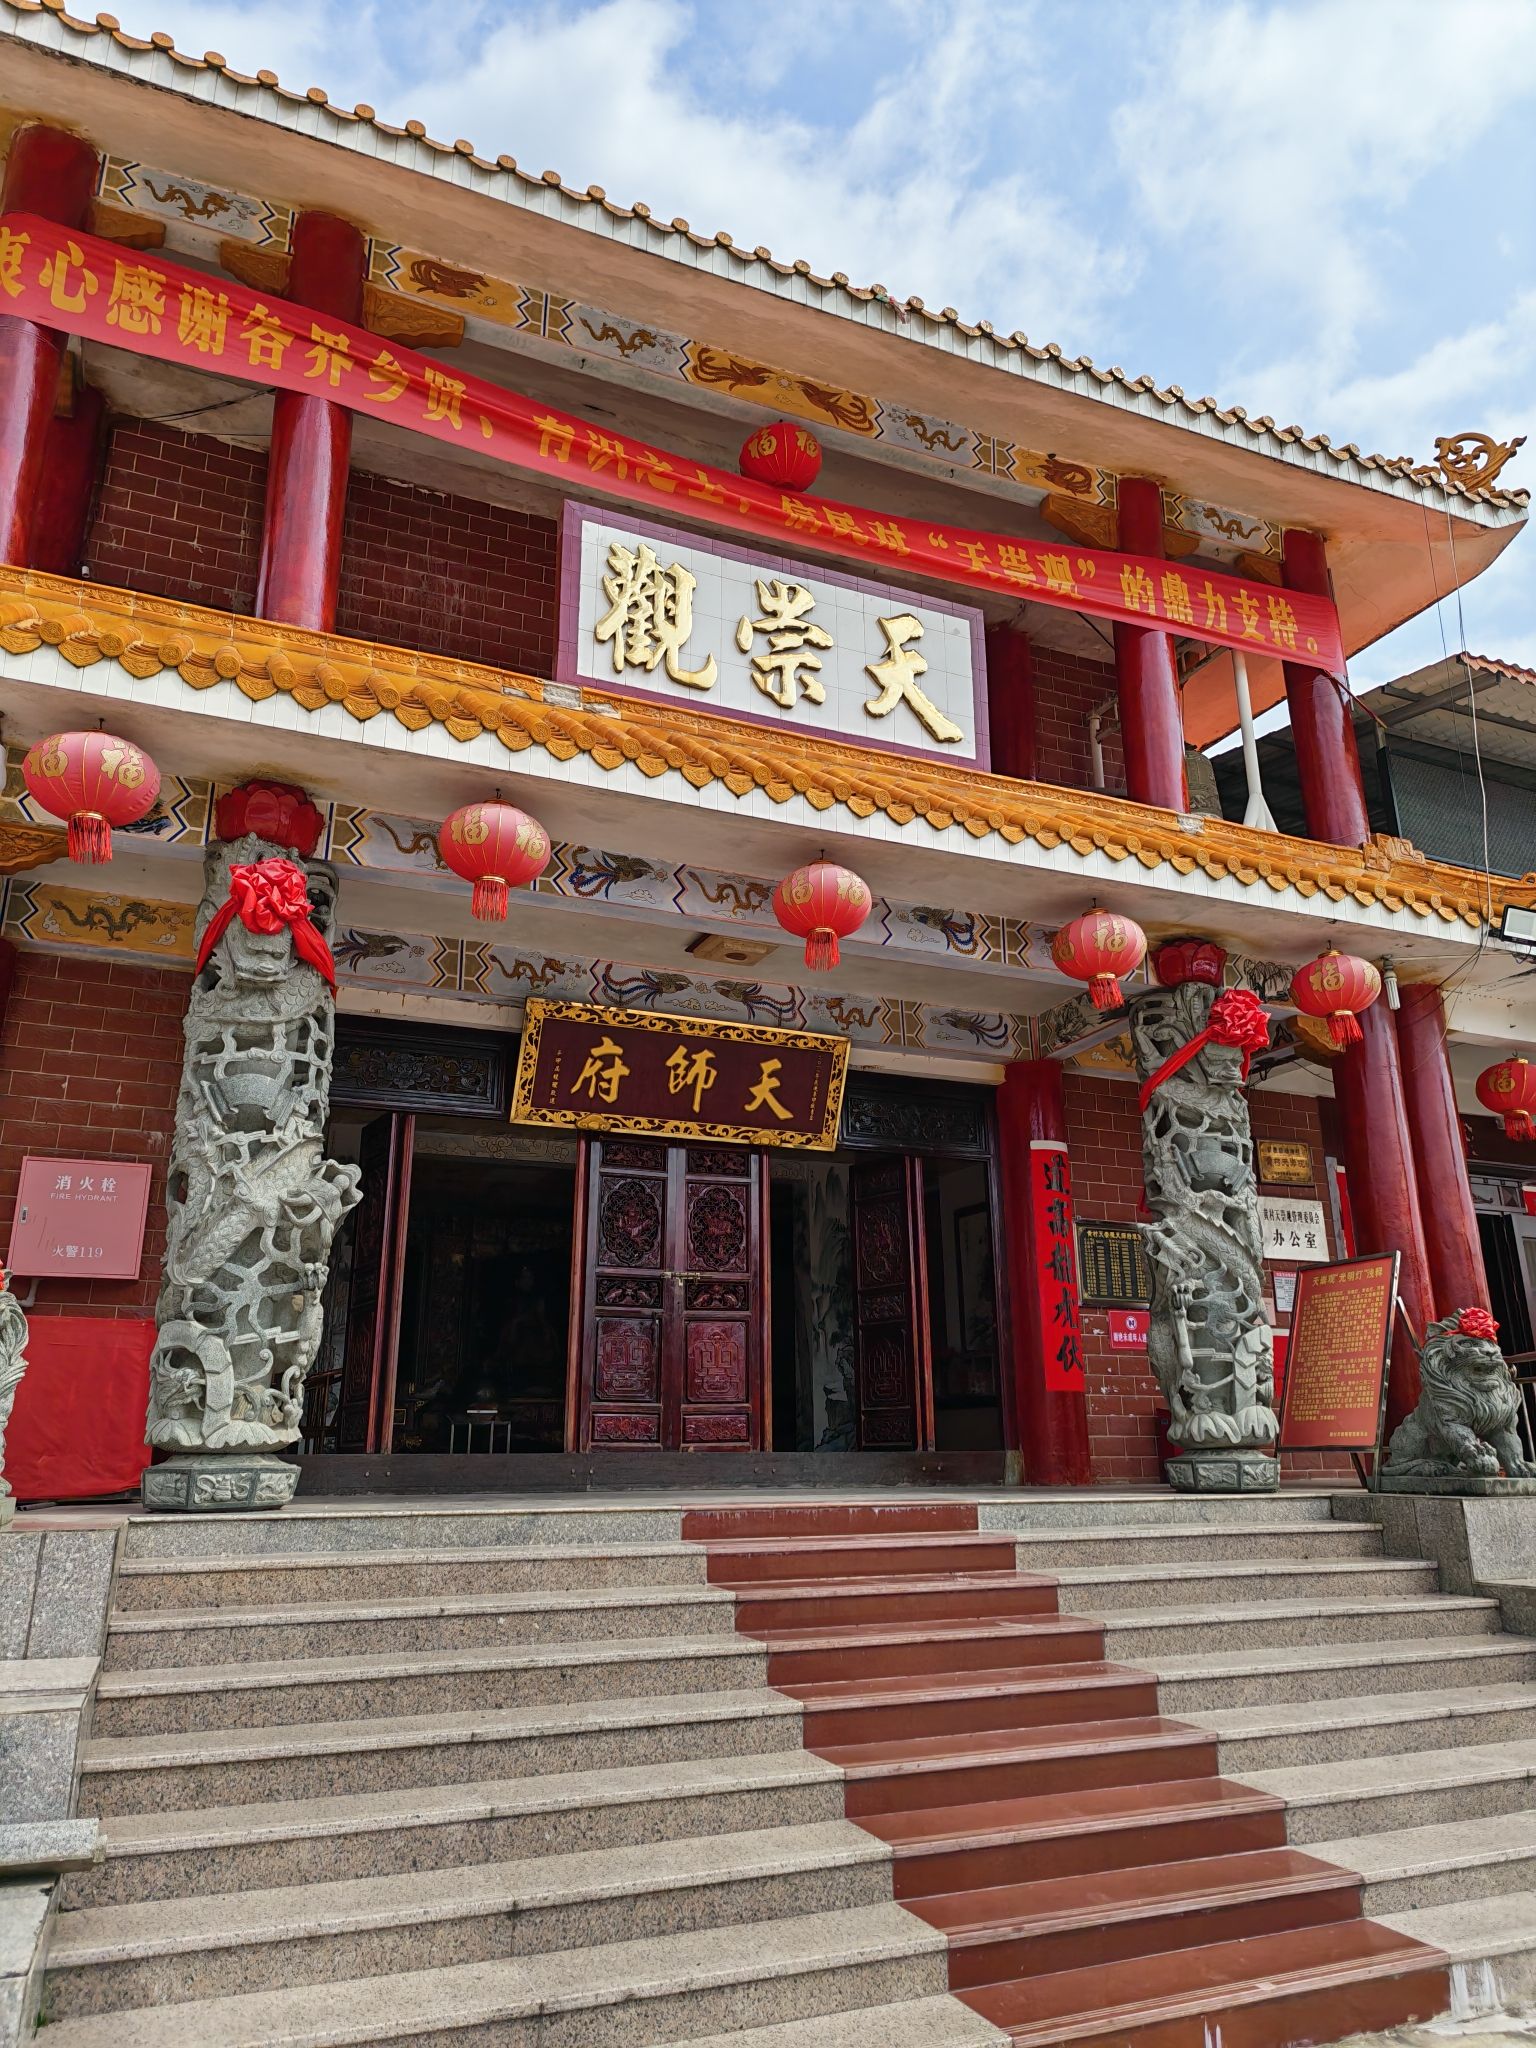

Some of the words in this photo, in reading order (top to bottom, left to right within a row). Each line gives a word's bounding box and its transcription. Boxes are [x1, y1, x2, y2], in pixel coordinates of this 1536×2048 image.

[101, 738, 146, 789] 福
[450, 805, 491, 846] 福
[515, 813, 547, 860] 福
[782, 869, 815, 905] 福
[837, 867, 873, 907] 福
[1092, 920, 1128, 953] 福
[1309, 961, 1346, 992] 福
[570, 1036, 795, 1121] 天師府
[55, 1175, 117, 1193] 消火栓
[75, 1194, 118, 1202] HYDRANT
[52, 1245, 103, 1258] 火警119
[1273, 1229, 1317, 1249] 办公室
